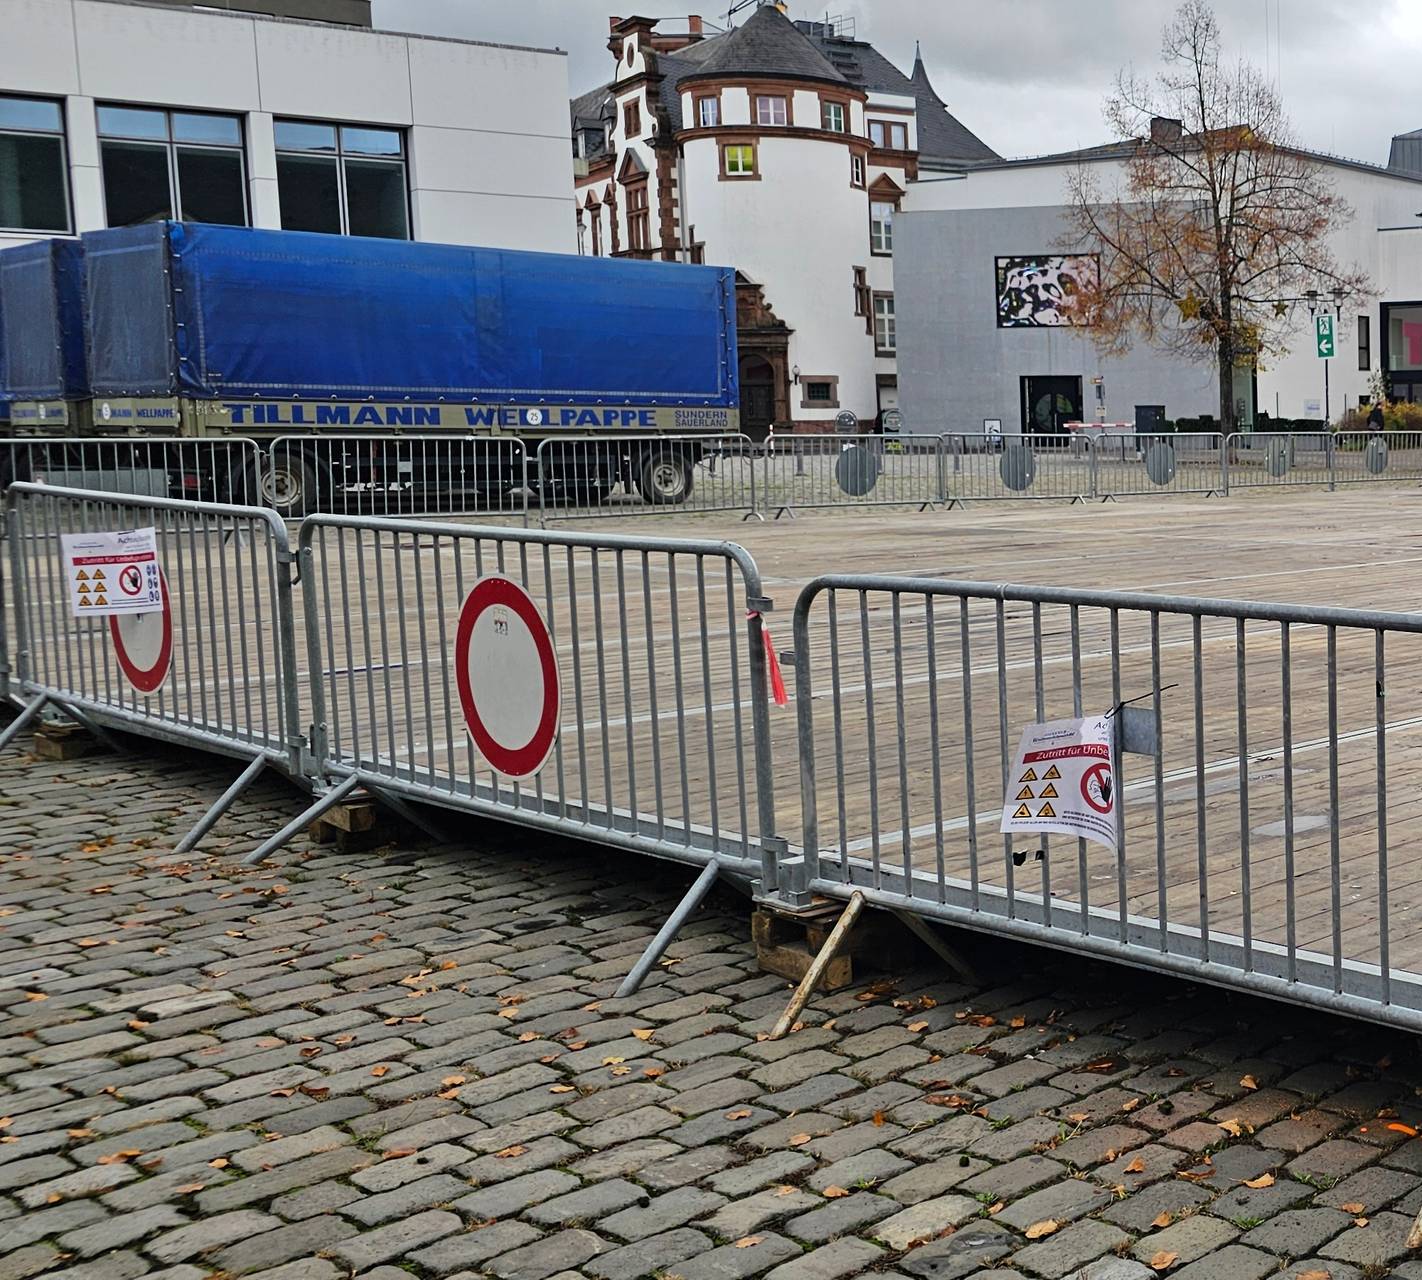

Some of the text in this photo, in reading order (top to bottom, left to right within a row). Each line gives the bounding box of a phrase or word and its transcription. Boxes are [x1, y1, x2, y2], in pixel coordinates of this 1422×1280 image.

[137, 408, 175, 418] WELLPAPPE
[222, 403, 657, 427] TILLMANN WELLPAPPE
[675, 410, 728, 420] SUNDERN
[675, 418, 729, 428] SAUERLAND
[1036, 749, 1065, 760] Zutritt
[1067, 746, 1081, 756] für
